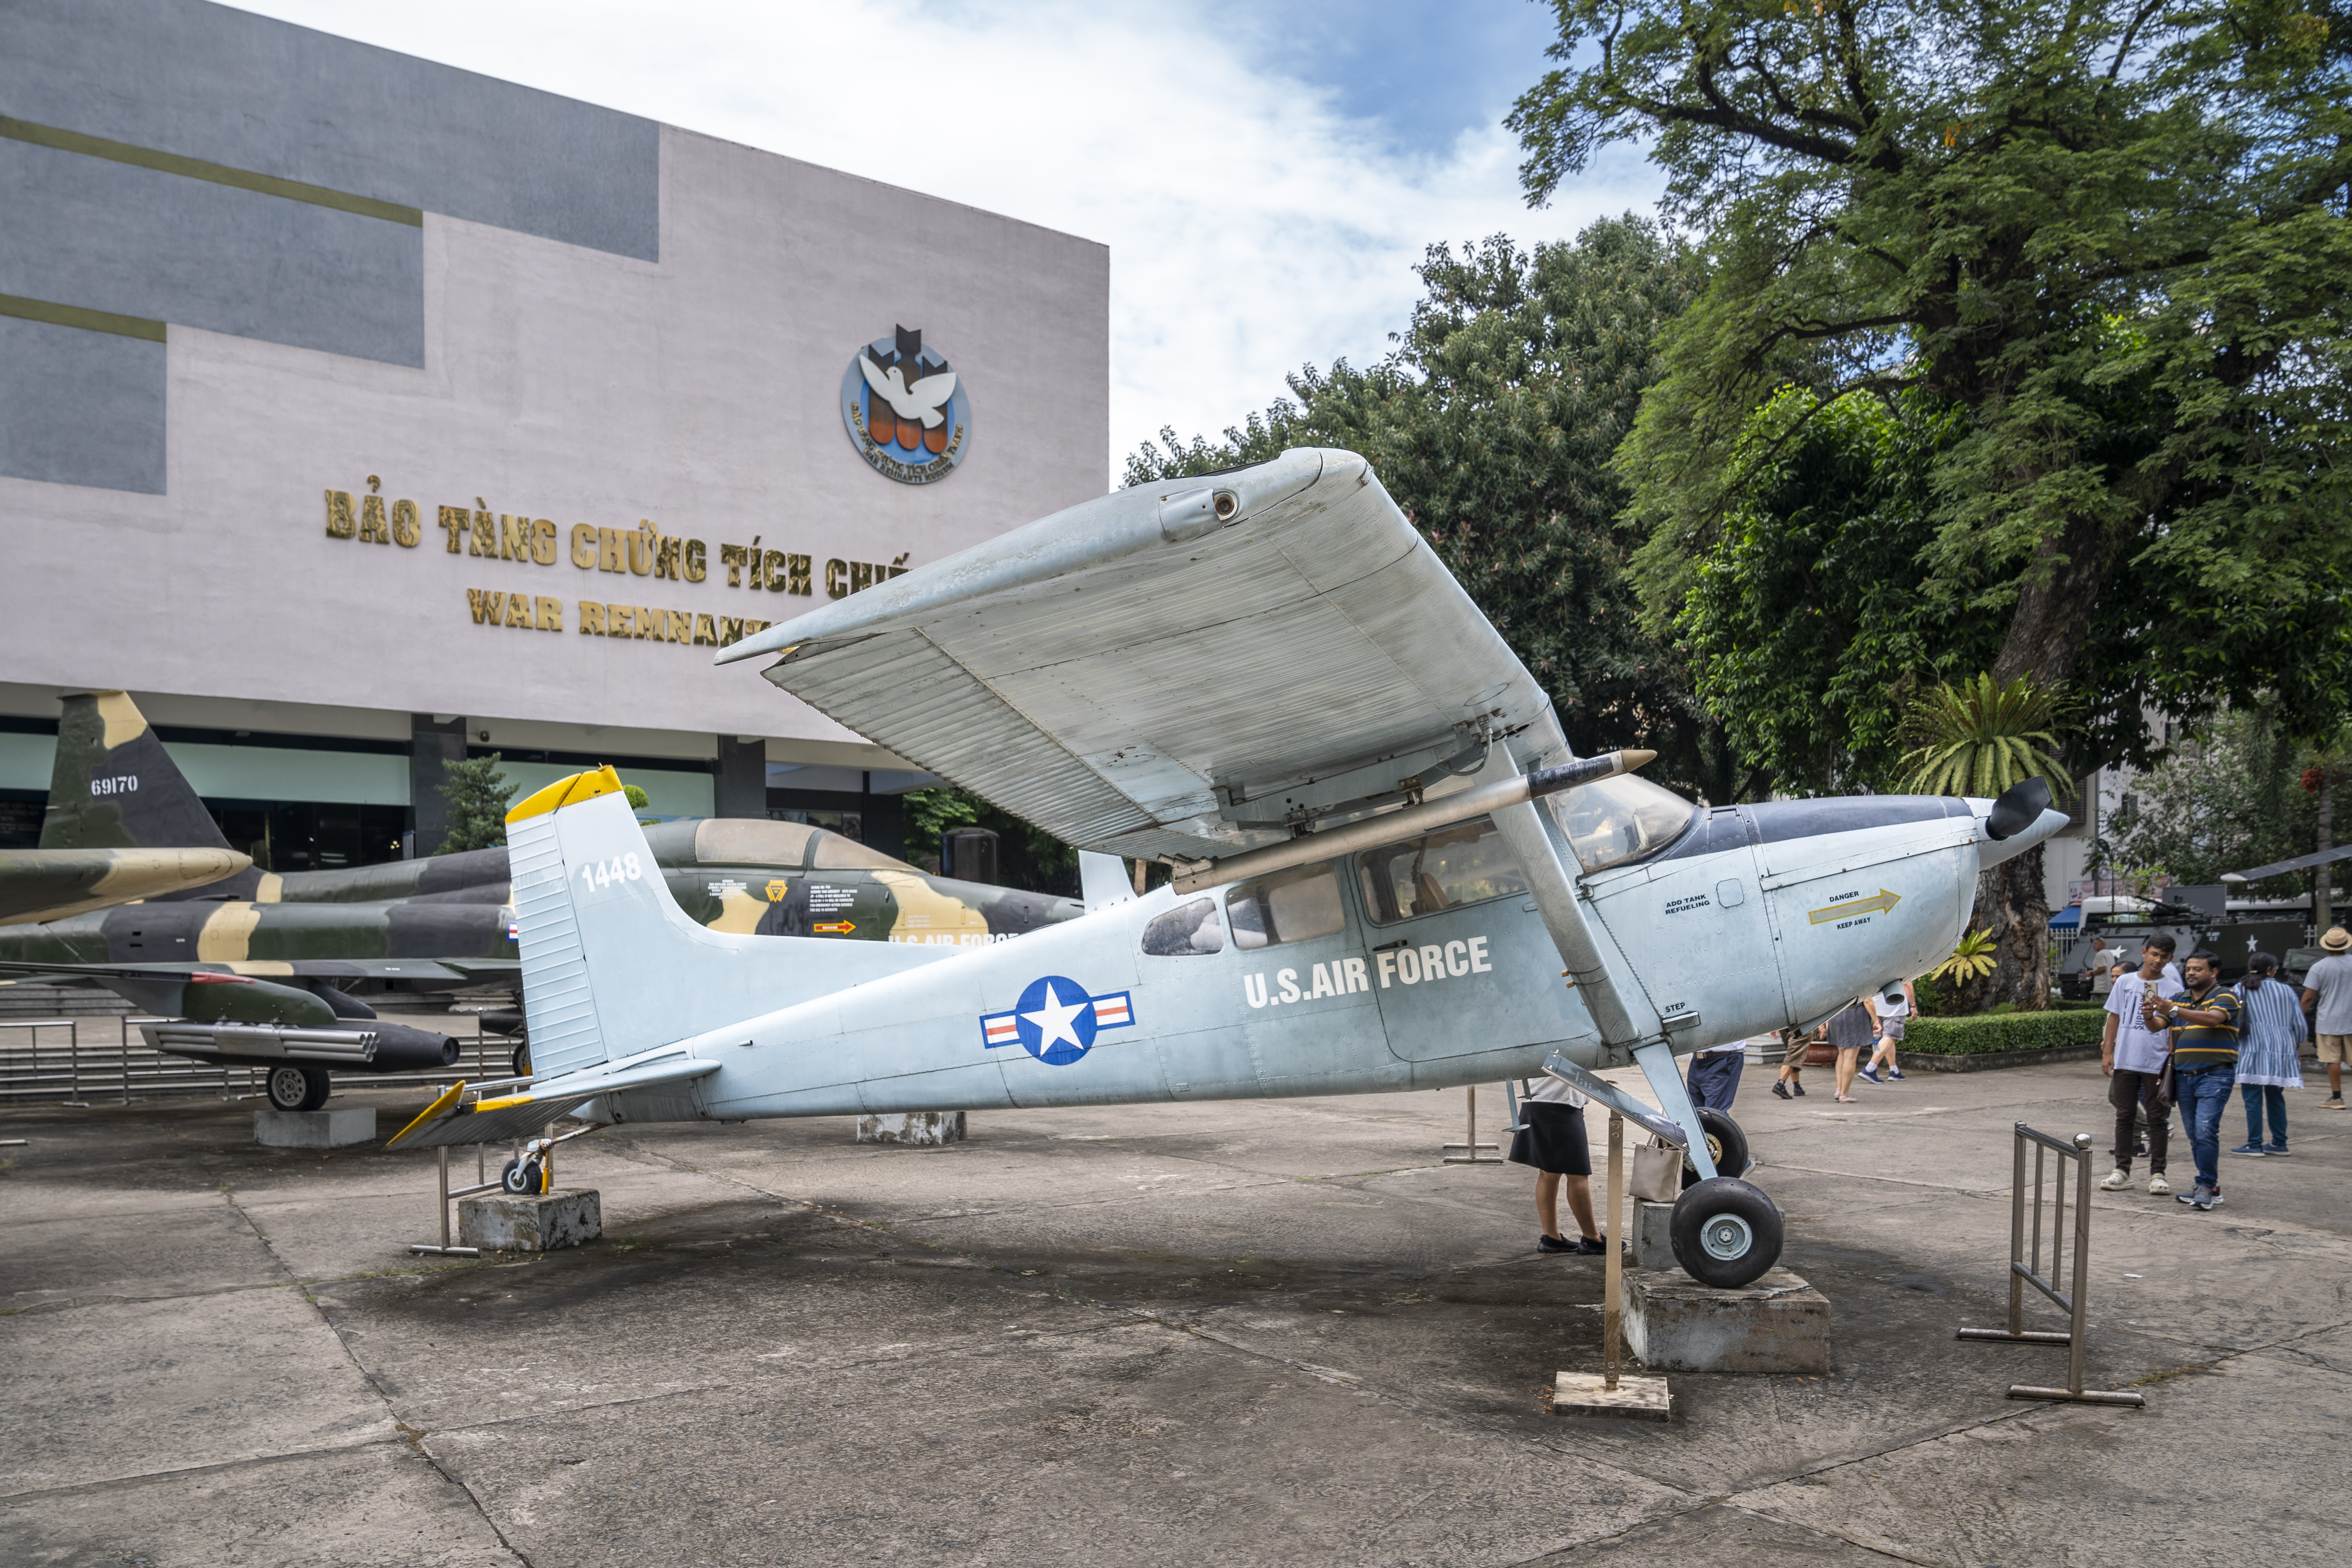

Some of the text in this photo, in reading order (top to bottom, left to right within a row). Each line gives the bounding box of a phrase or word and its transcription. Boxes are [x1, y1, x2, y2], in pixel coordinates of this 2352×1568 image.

[864, 448, 878, 465] WAR
[325, 475, 421, 548] BẢO
[439, 496, 557, 565] TÀNG
[571, 519, 706, 582] CHỨNG
[721, 535, 812, 595] TÍCH
[467, 588, 785, 649] WAR REMNANT
[91, 775, 138, 796] 69170
[582, 851, 642, 893] 1448
[1666, 894, 1706, 908] ADD TANK
[1829, 891, 1859, 902] DANGER
[1665, 900, 1710, 915] REFUELING
[1837, 916, 1871, 930] KEEP AWAY
[1376, 935, 1492, 989] FORCE
[1665, 1002, 1685, 1013] STEP
